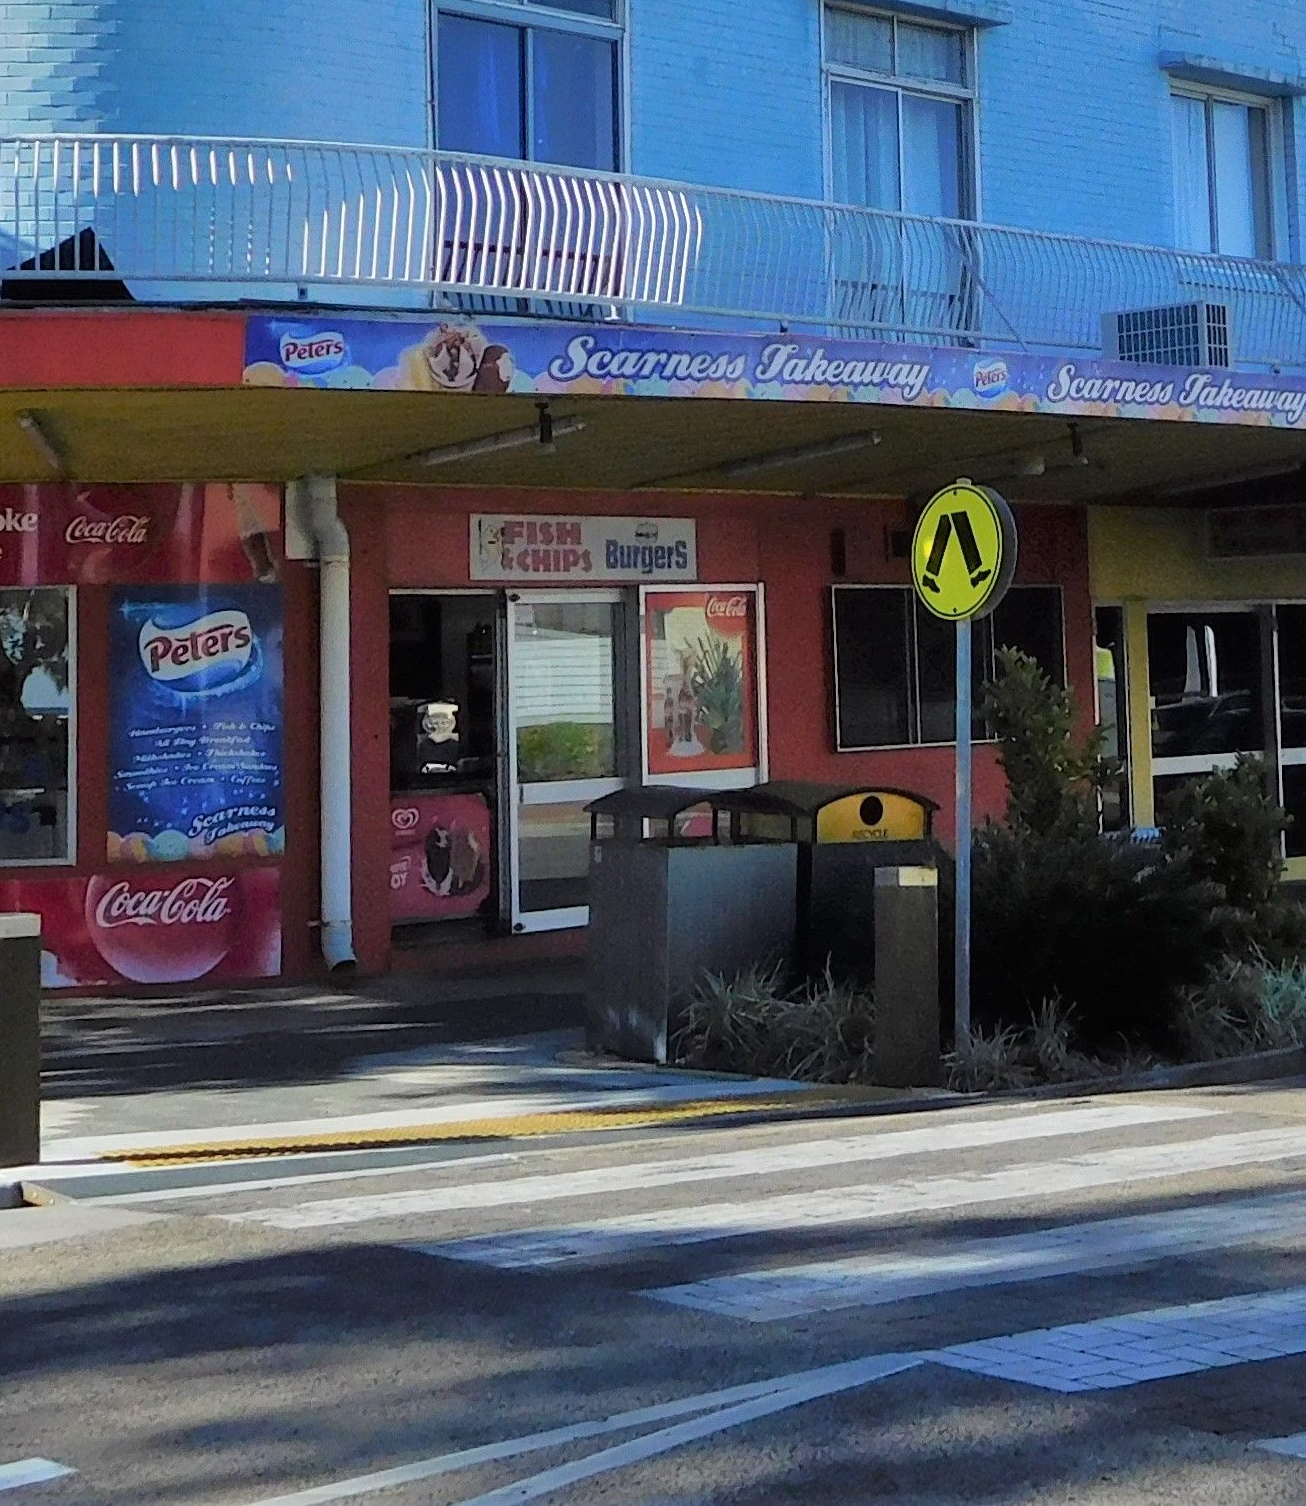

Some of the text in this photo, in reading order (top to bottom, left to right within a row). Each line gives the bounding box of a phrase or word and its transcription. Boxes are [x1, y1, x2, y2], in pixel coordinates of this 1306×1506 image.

[281, 341, 345, 363] Peters
[548, 335, 931, 398] Scarness Takeaway
[1047, 364, 1173, 402] Scarness
[501, 521, 583, 546] FISH
[515, 548, 593, 573] CHIPS
[143, 624, 251, 673] Peters
[189, 805, 276, 837] Scarness
